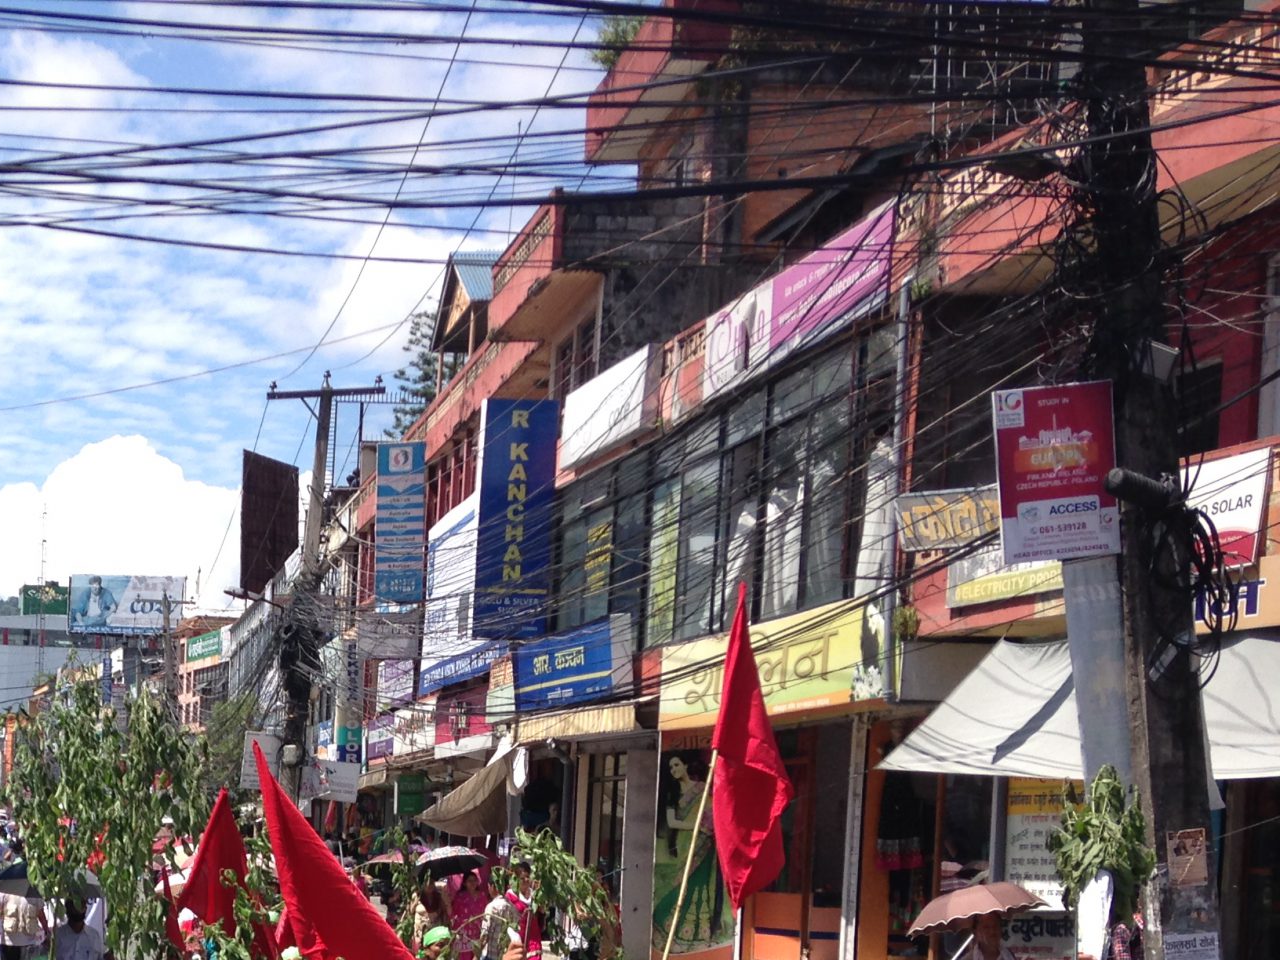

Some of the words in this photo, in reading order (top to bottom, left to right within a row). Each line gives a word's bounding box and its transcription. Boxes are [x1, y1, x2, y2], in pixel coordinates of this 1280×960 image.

[512, 409, 530, 429] R
[502, 442, 529, 582] KANCHAN
[1049, 501, 1098, 515] ACCESS
[1211, 494, 1254, 517] SOLAR
[962, 575, 1025, 600] ELECTRICITY
